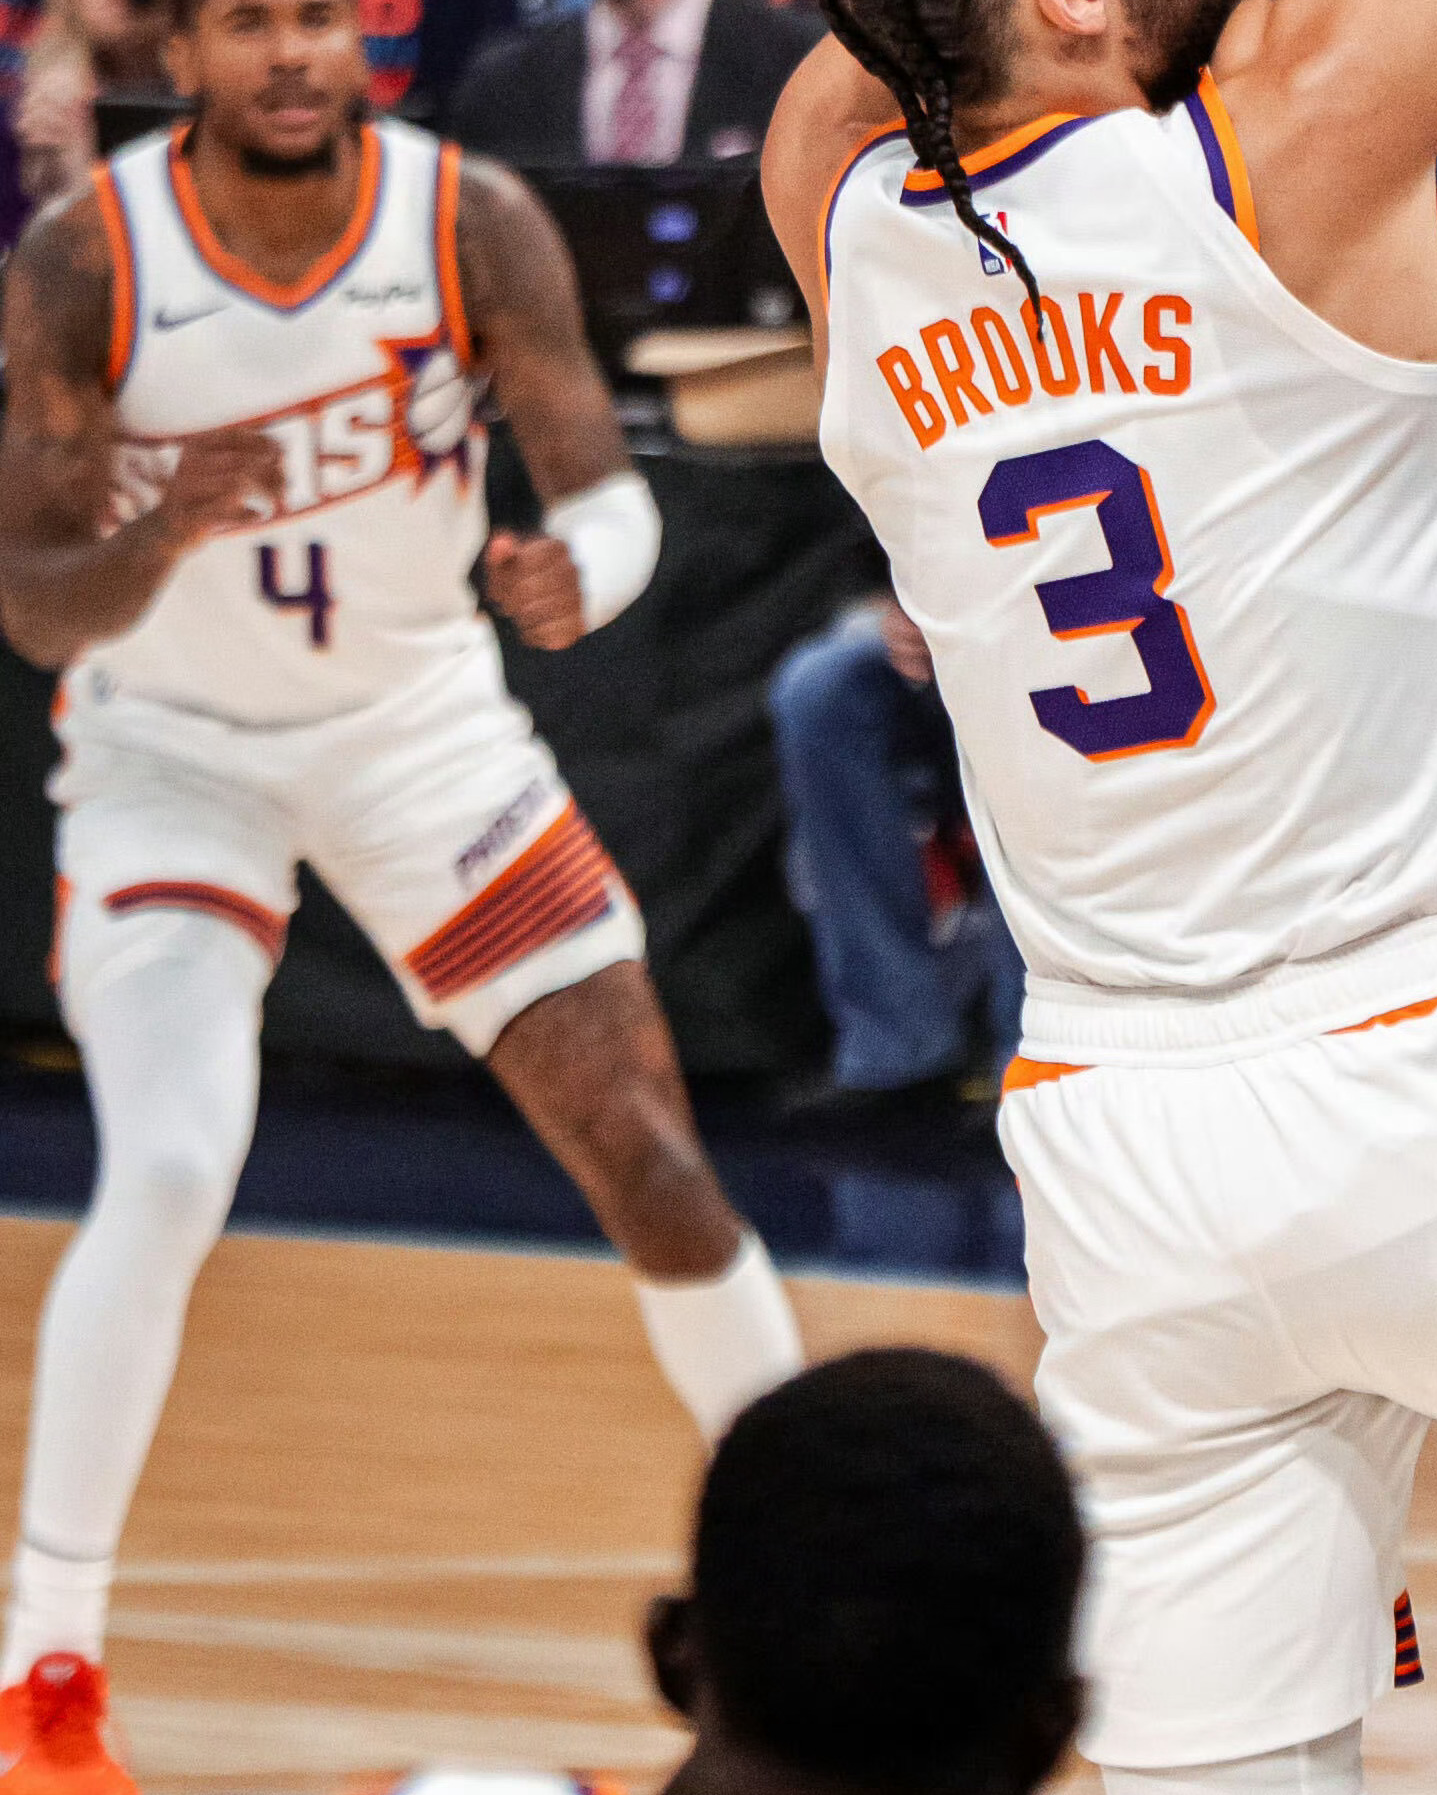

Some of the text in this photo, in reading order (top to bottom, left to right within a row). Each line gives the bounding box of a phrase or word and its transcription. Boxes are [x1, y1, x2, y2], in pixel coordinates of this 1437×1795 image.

[876, 291, 1193, 452] BROOKS
[258, 540, 338, 648] 4
[977, 438, 1218, 764] 3
